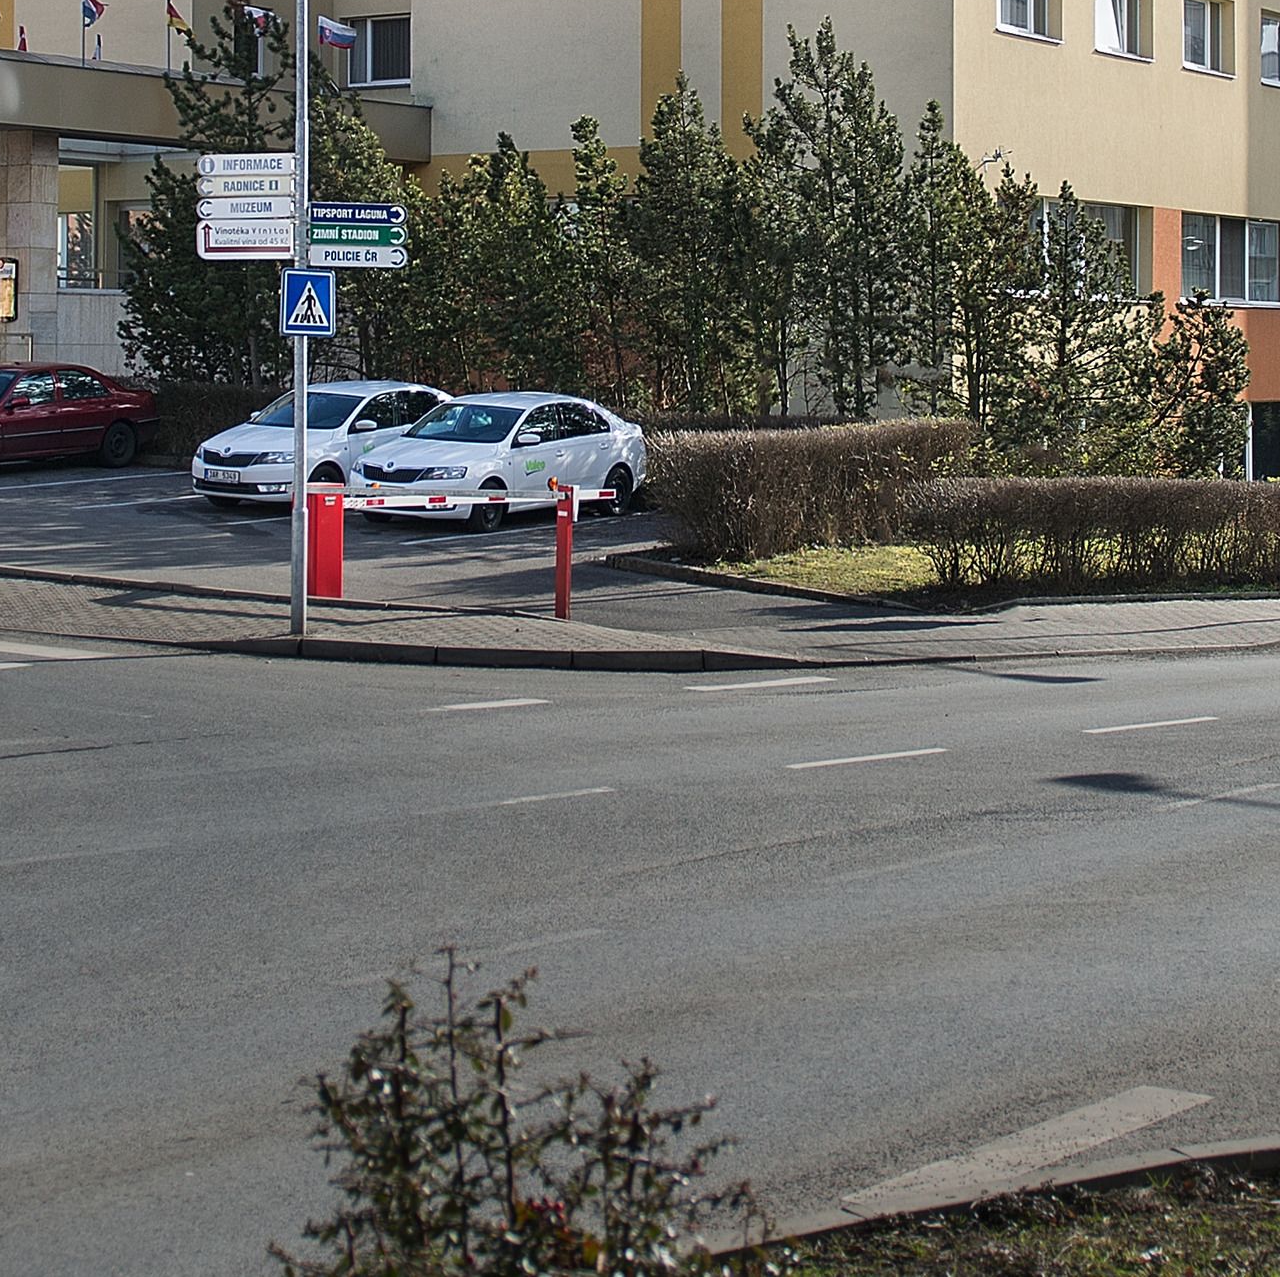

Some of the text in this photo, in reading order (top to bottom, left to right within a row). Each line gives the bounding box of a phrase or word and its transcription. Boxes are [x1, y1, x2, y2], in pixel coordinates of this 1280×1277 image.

[222, 158, 283, 171] INFORMACE
[223, 180, 265, 192] RADNICE
[230, 202, 272, 213] MUZEUM
[312, 208, 388, 220] TIPSPORT LAGUNA
[312, 226, 379, 240] ZIMNÍ STADION
[324, 249, 378, 262] POLICIE ČR
